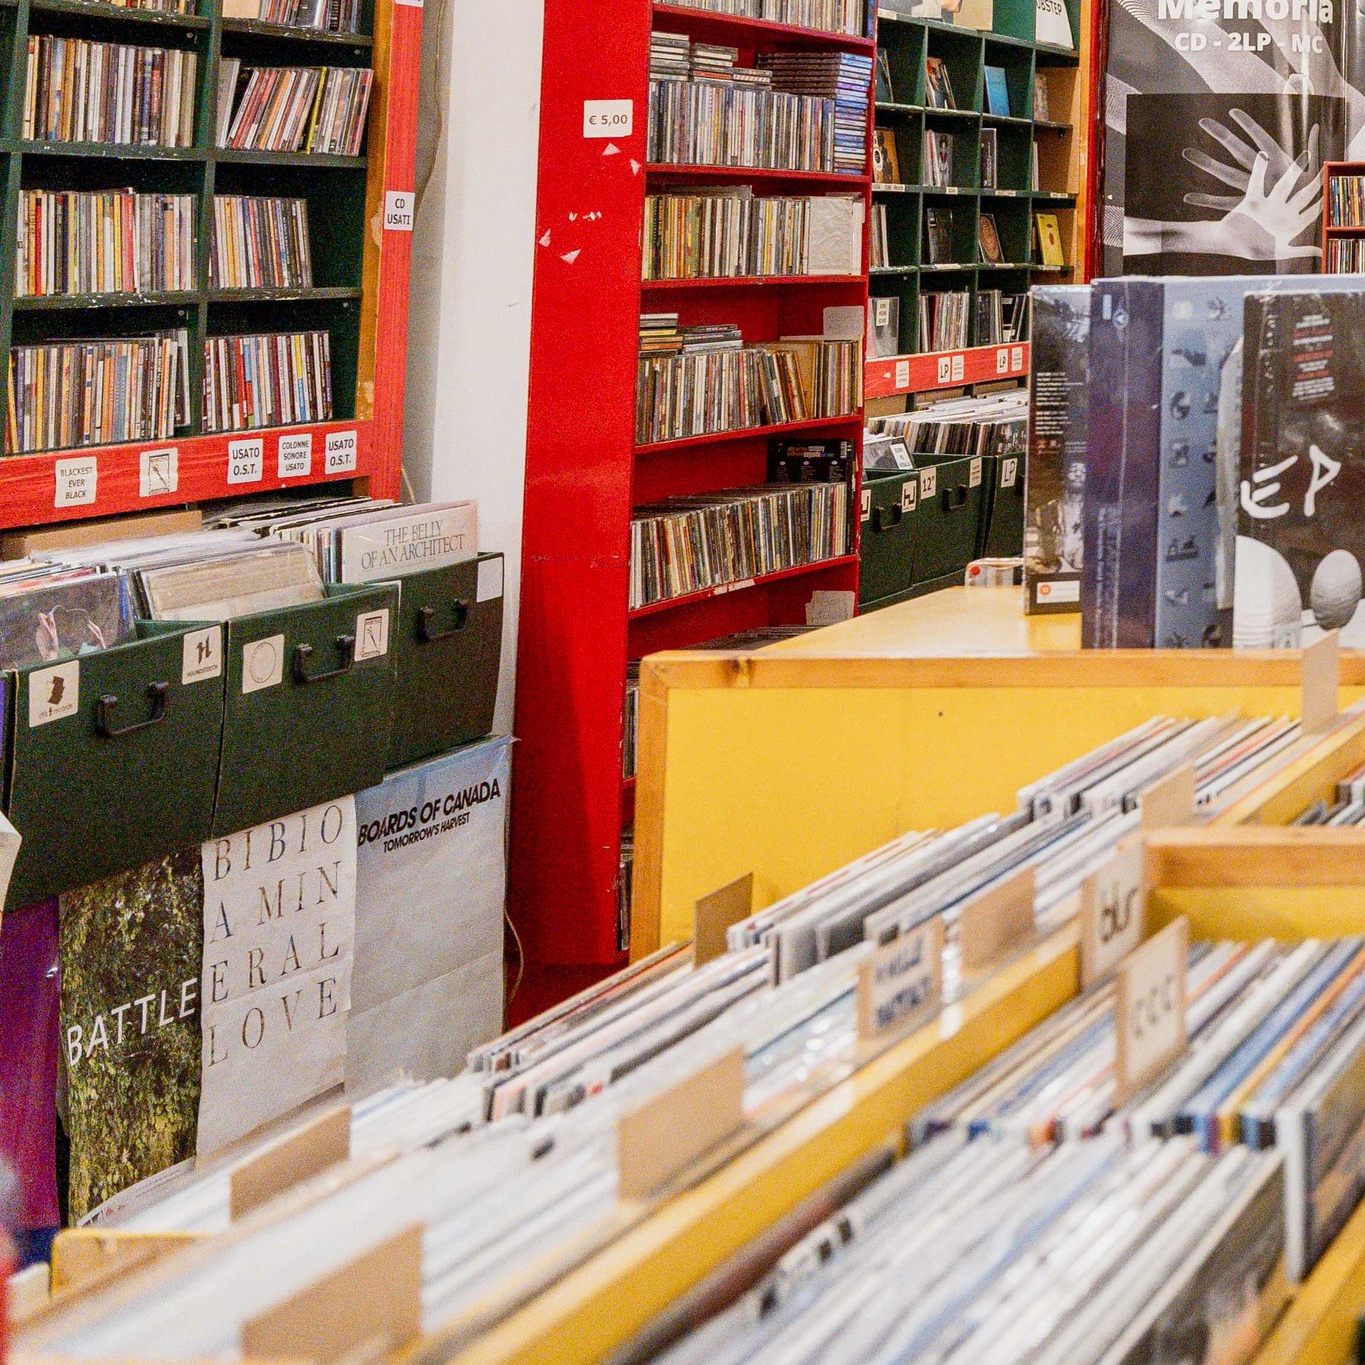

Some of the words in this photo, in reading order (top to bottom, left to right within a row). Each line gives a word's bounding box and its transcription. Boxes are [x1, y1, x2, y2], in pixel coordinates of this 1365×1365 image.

[1174, 32, 1206, 53] CD
[1227, 32, 1272, 52] 2LP
[1290, 33, 1324, 55] MC
[600, 114, 628, 126] 5,00
[394, 198, 406, 210] CD
[387, 213, 411, 226] USATI
[997, 353, 1008, 368] LP
[938, 363, 950, 376] LP
[281, 439, 310, 451] COLONNE
[327, 438, 355, 452] USATO
[232, 446, 261, 461] USATO
[283, 451, 308, 462] SONORE
[329, 453, 353, 467] O.S.T.
[60, 465, 93, 478] BLACKEST
[233, 463, 258, 477] O.S.T.
[285, 461, 305, 472] USATO
[1003, 459, 1017, 480] LP
[68, 478, 86, 489] EVER
[65, 489, 87, 500] BLACK
[384, 526, 409, 548] THE
[411, 520, 443, 544] BELLY
[361, 550, 381, 570] OF
[381, 546, 399, 566] AN
[399, 533, 466, 562] ARCHITECT
[357, 806, 418, 848] BOARDS
[419, 799, 442, 823] OF
[443, 778, 501, 817] CANADA
[383, 824, 441, 854] TOMORROW'S
[440, 811, 471, 835] HARVEST
[214, 804, 343, 882] BIBIO
[210, 900, 234, 944] A
[258, 860, 343, 926] MIN
[210, 922, 340, 1005] ERAL
[66, 977, 197, 1067] BATTLE
[208, 977, 338, 1067] LOVE
